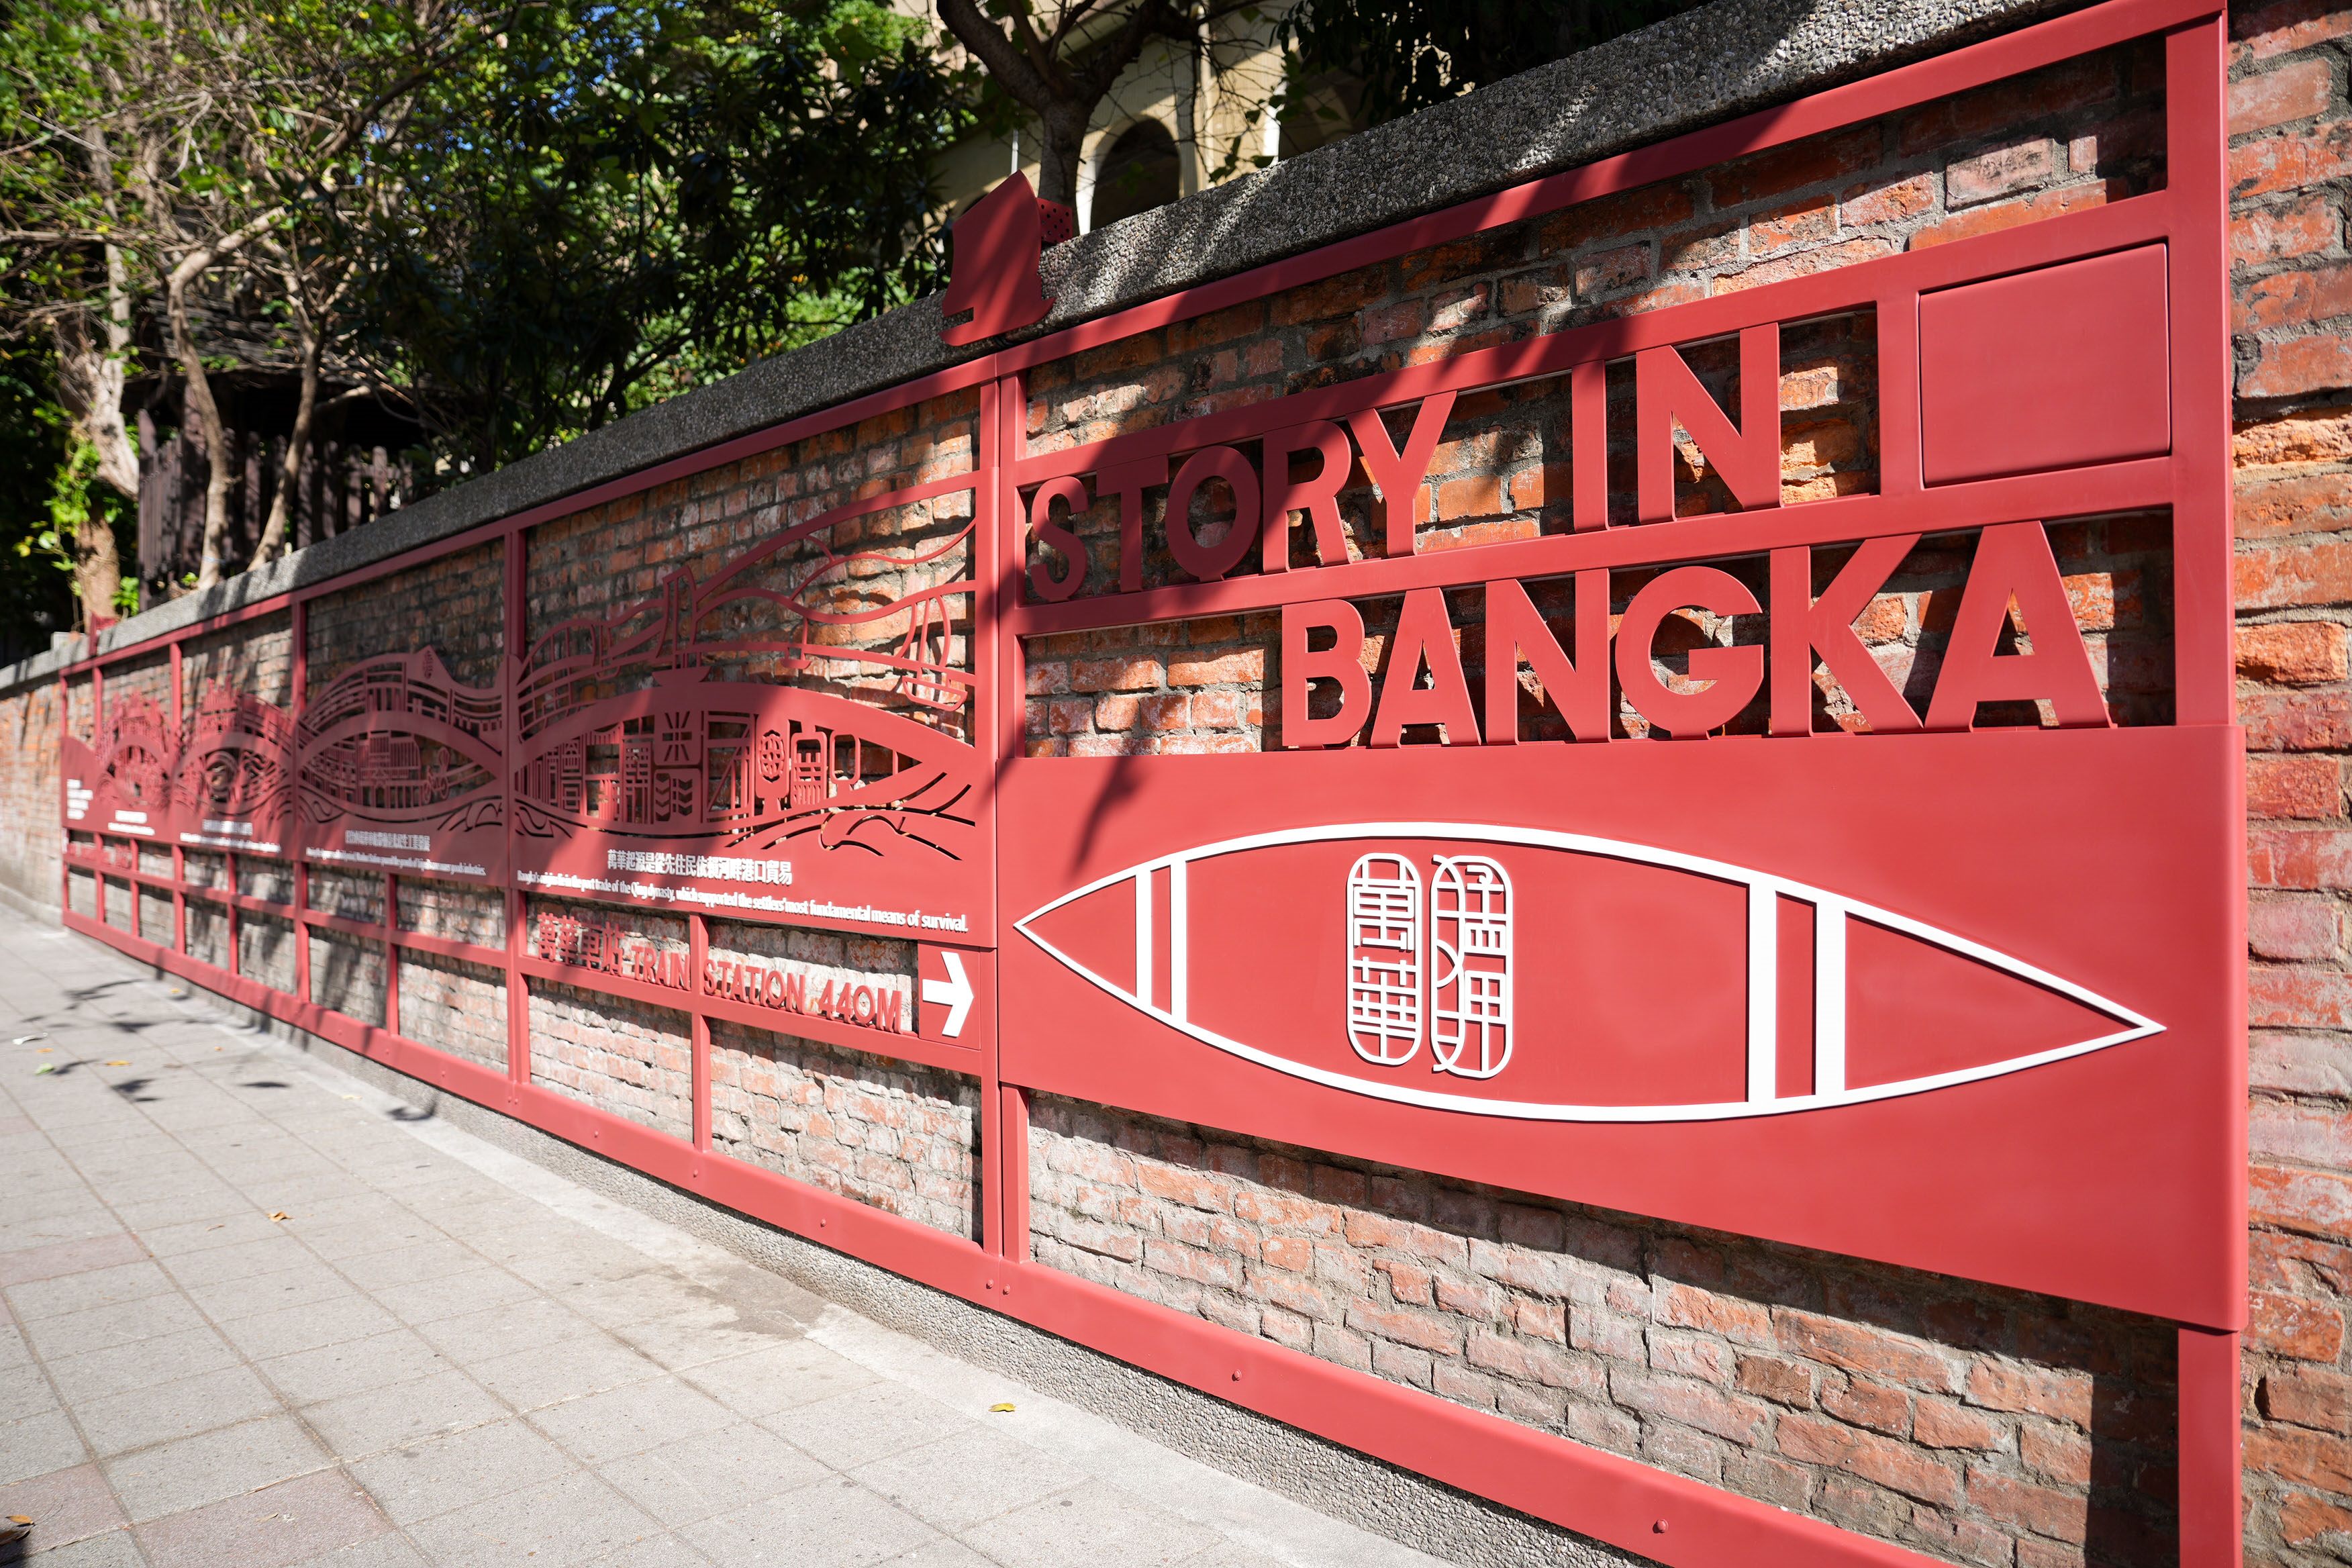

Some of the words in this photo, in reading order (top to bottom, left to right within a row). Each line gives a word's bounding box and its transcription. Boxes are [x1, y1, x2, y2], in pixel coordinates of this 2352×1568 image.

[1030, 391, 1458, 604] STORY
[1572, 322, 1782, 530] IN
[1281, 521, 2114, 748] BANGKA
[595, 879, 611, 891] trade
[611, 880, 618, 892] of
[620, 881, 630, 893] the
[697, 892, 736, 908] supported
[737, 893, 752, 908] the
[785, 900, 808, 914] most
[809, 899, 870, 922] fundamental
[871, 910, 905, 926] means
[907, 910, 920, 927] of
[921, 913, 968, 935] survival.
[631, 944, 691, 991] TRAIN
[703, 959, 805, 1014] STATION
[818, 979, 903, 1034] 440M
